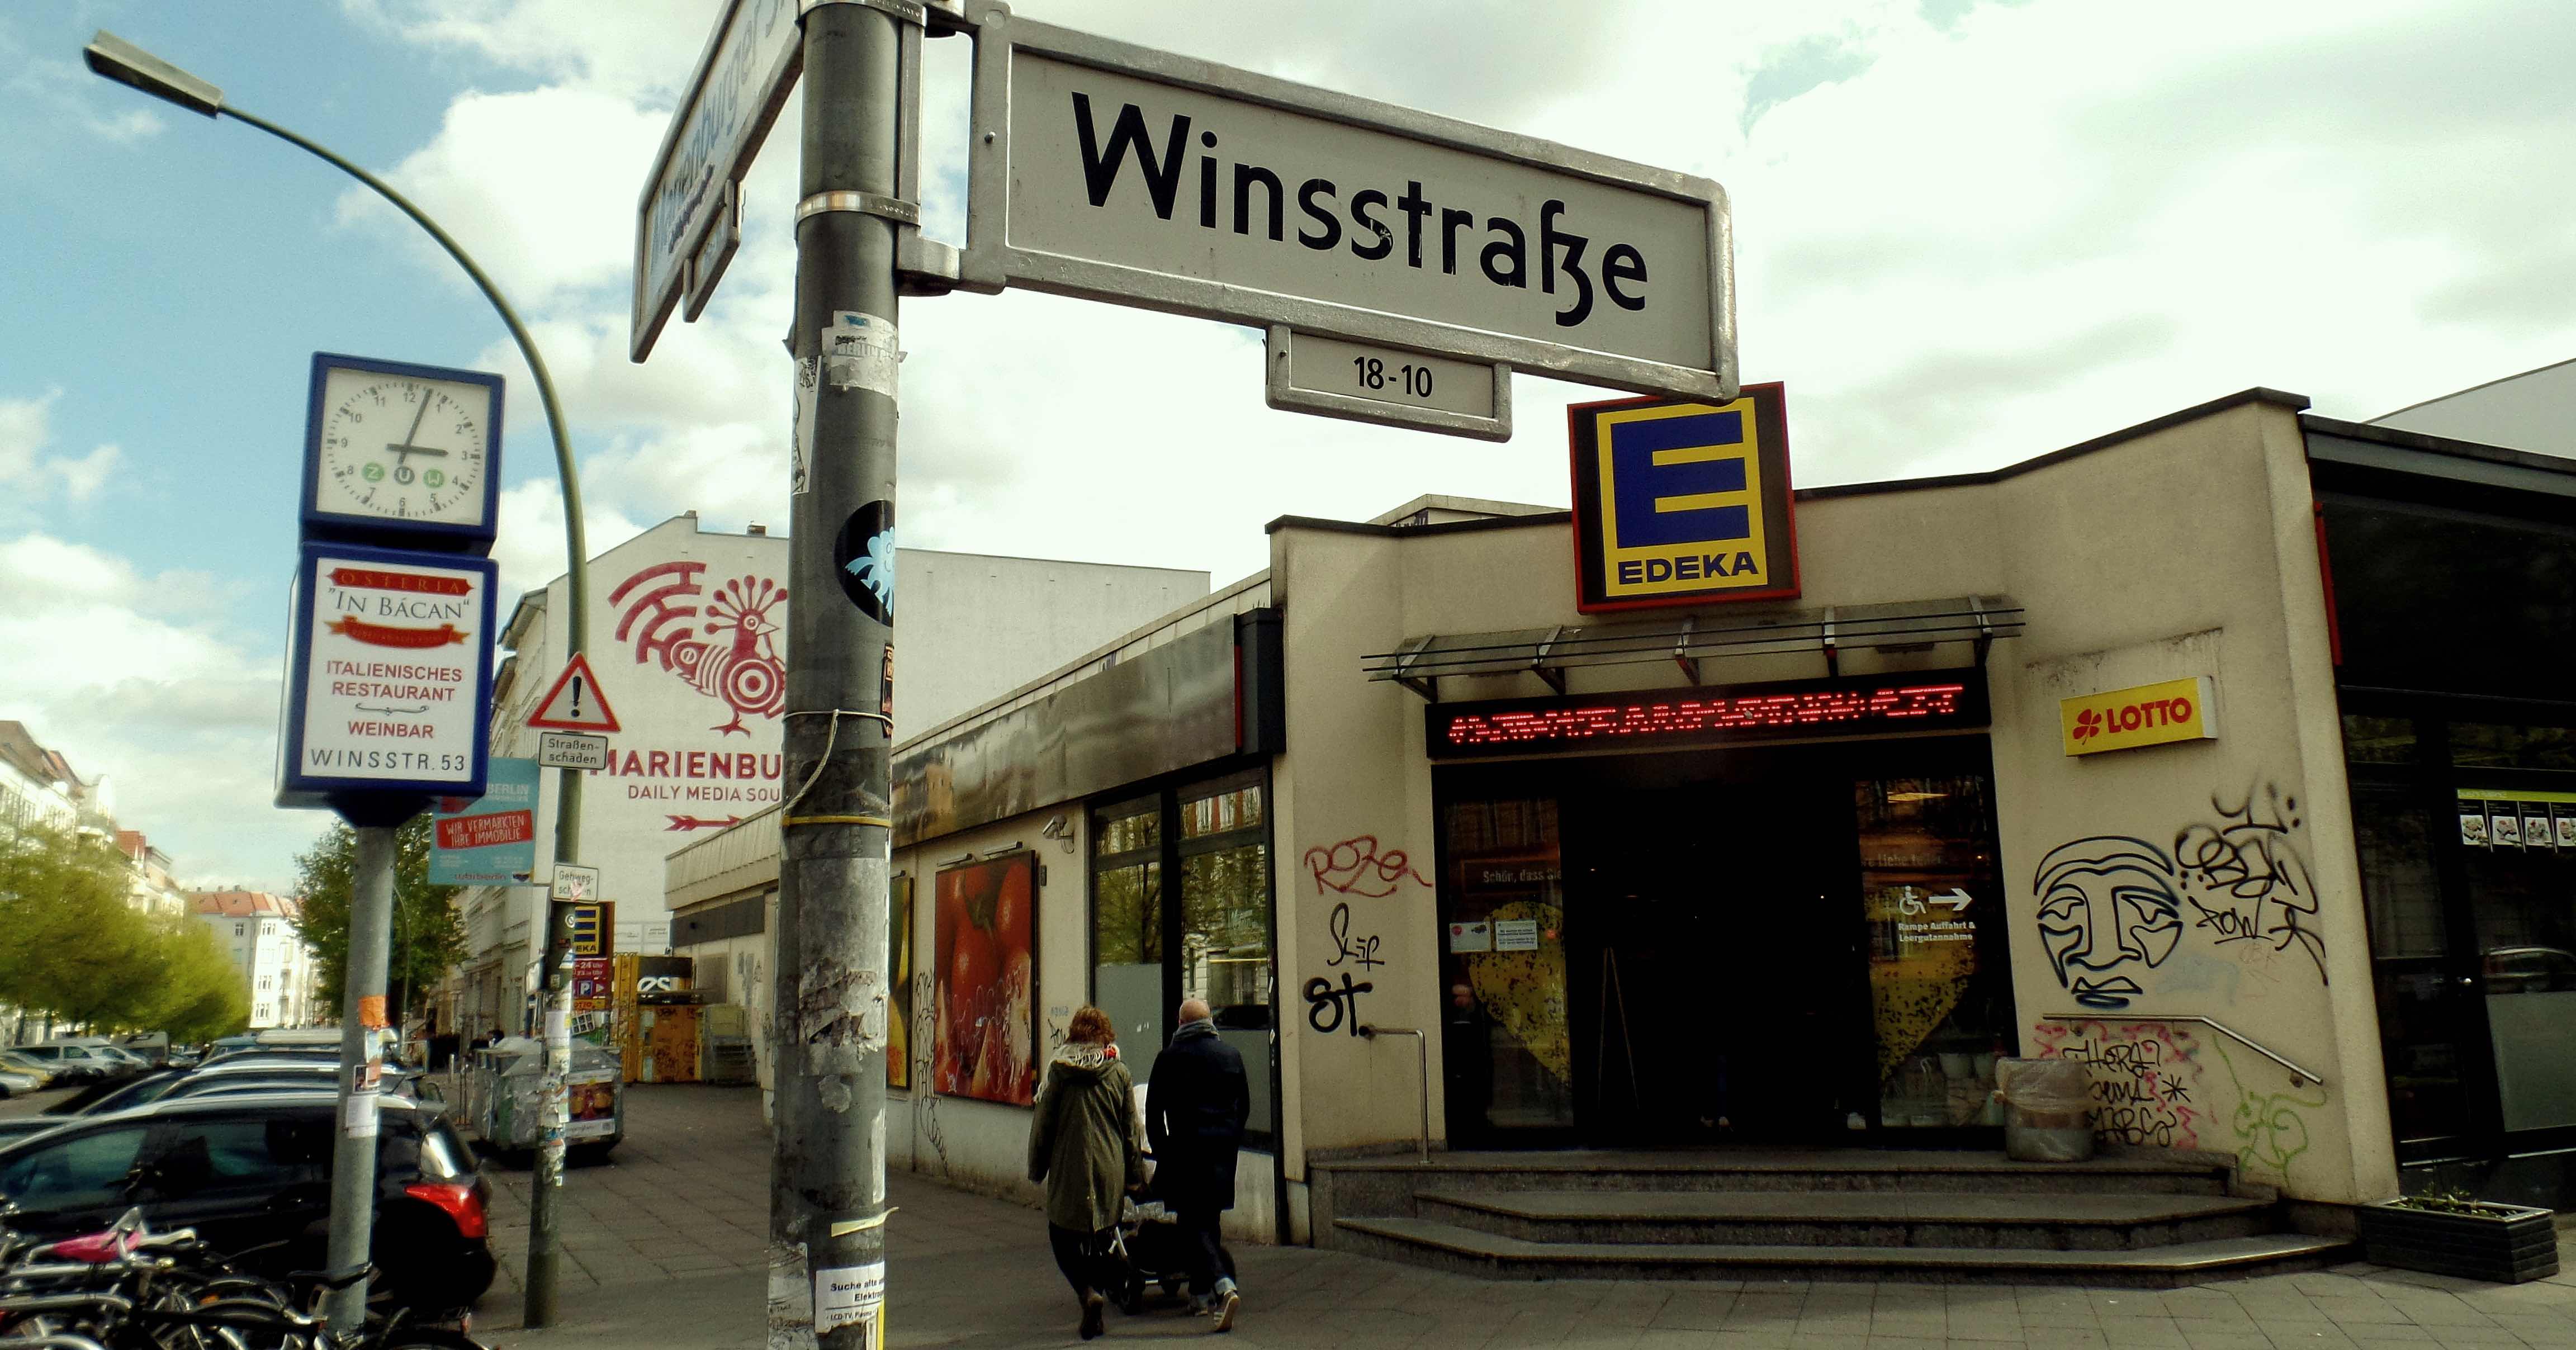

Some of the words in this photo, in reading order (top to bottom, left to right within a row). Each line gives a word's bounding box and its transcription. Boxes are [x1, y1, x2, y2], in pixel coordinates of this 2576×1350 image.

[1071, 91, 1647, 327] Winsstraße
[1353, 356, 1433, 397] 18-10
[374, 396, 386, 407] 11
[403, 392, 416, 403] 12
[350, 412, 362, 423] 10
[1618, 551, 1759, 585] EDEKA
[340, 571, 460, 593] OSTERIA
[326, 660, 463, 682] ITALIENISCHES
[332, 682, 456, 702] RESTAURANT
[2106, 697, 2193, 733] LOTTO
[348, 721, 434, 739] WEINBAR
[548, 738, 599, 750] Straßen-
[311, 749, 435, 771] WINSSTR.
[441, 755, 465, 771] 53
[628, 785, 680, 800] DAILY
[686, 786, 741, 801] MEDIA
[746, 787, 780, 802] SOU
[446, 822, 463, 835] WIR
[467, 815, 524, 832] VERMARKTEN
[451, 833, 470, 847] IHRE
[475, 828, 522, 844] IMMOBILIE
[1519, 869, 1544, 882] dass
[1898, 923, 1928, 932] Rampe
[1930, 921, 1967, 930] Auffahrt
[1900, 933, 1973, 943] Leergutannahme
[830, 1282, 862, 1292] Suche
